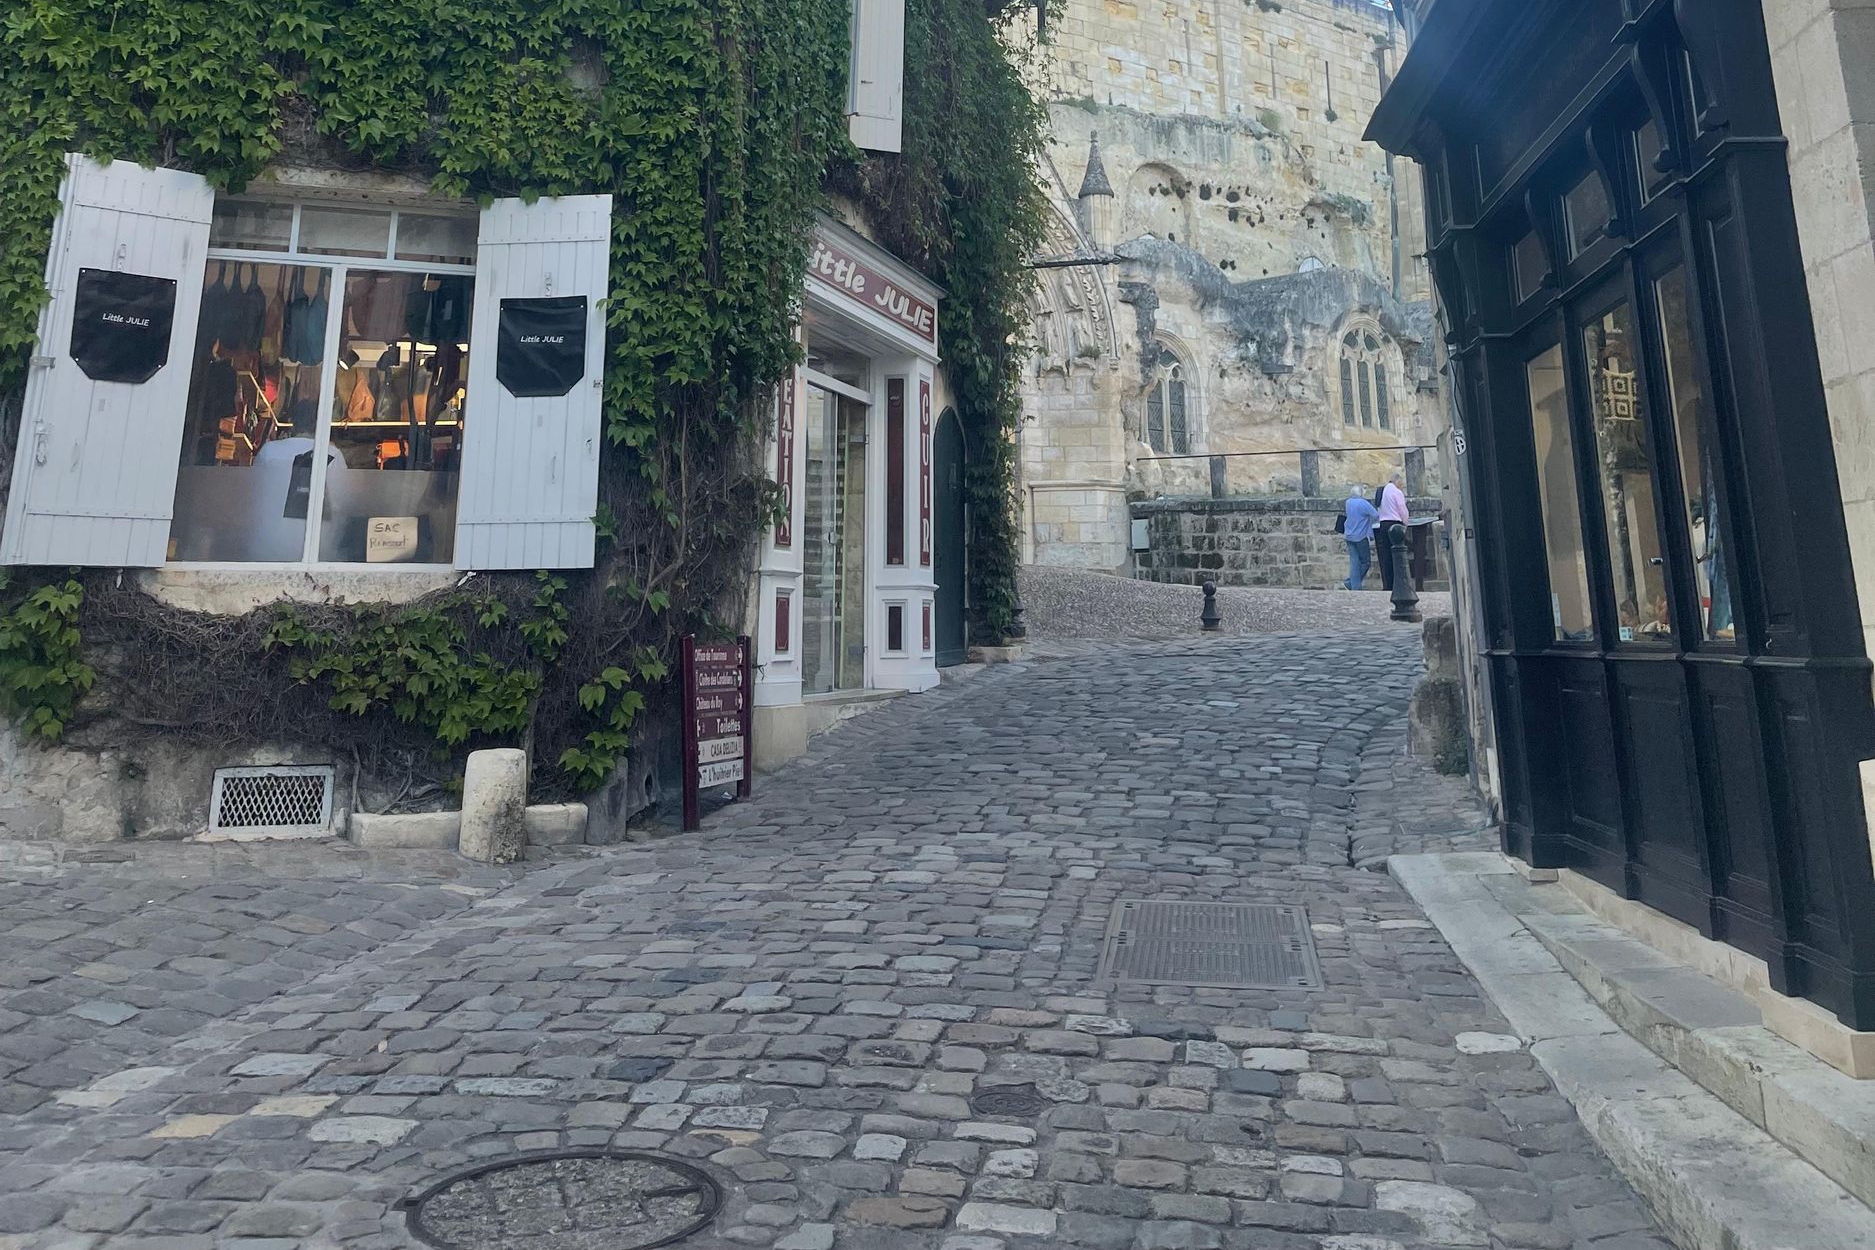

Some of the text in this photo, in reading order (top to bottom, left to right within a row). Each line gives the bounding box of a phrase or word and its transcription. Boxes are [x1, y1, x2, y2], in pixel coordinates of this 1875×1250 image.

[810, 242, 933, 332] ittle JULIE
[102, 312, 150, 327] Little JULIE
[520, 335, 564, 343] Little JULIE
[780, 378, 793, 537] EATION
[921, 393, 930, 552] CUIR
[373, 522, 401, 533] SAC
[717, 717, 741, 734] Toilettes
[710, 743, 722, 758] CASA
